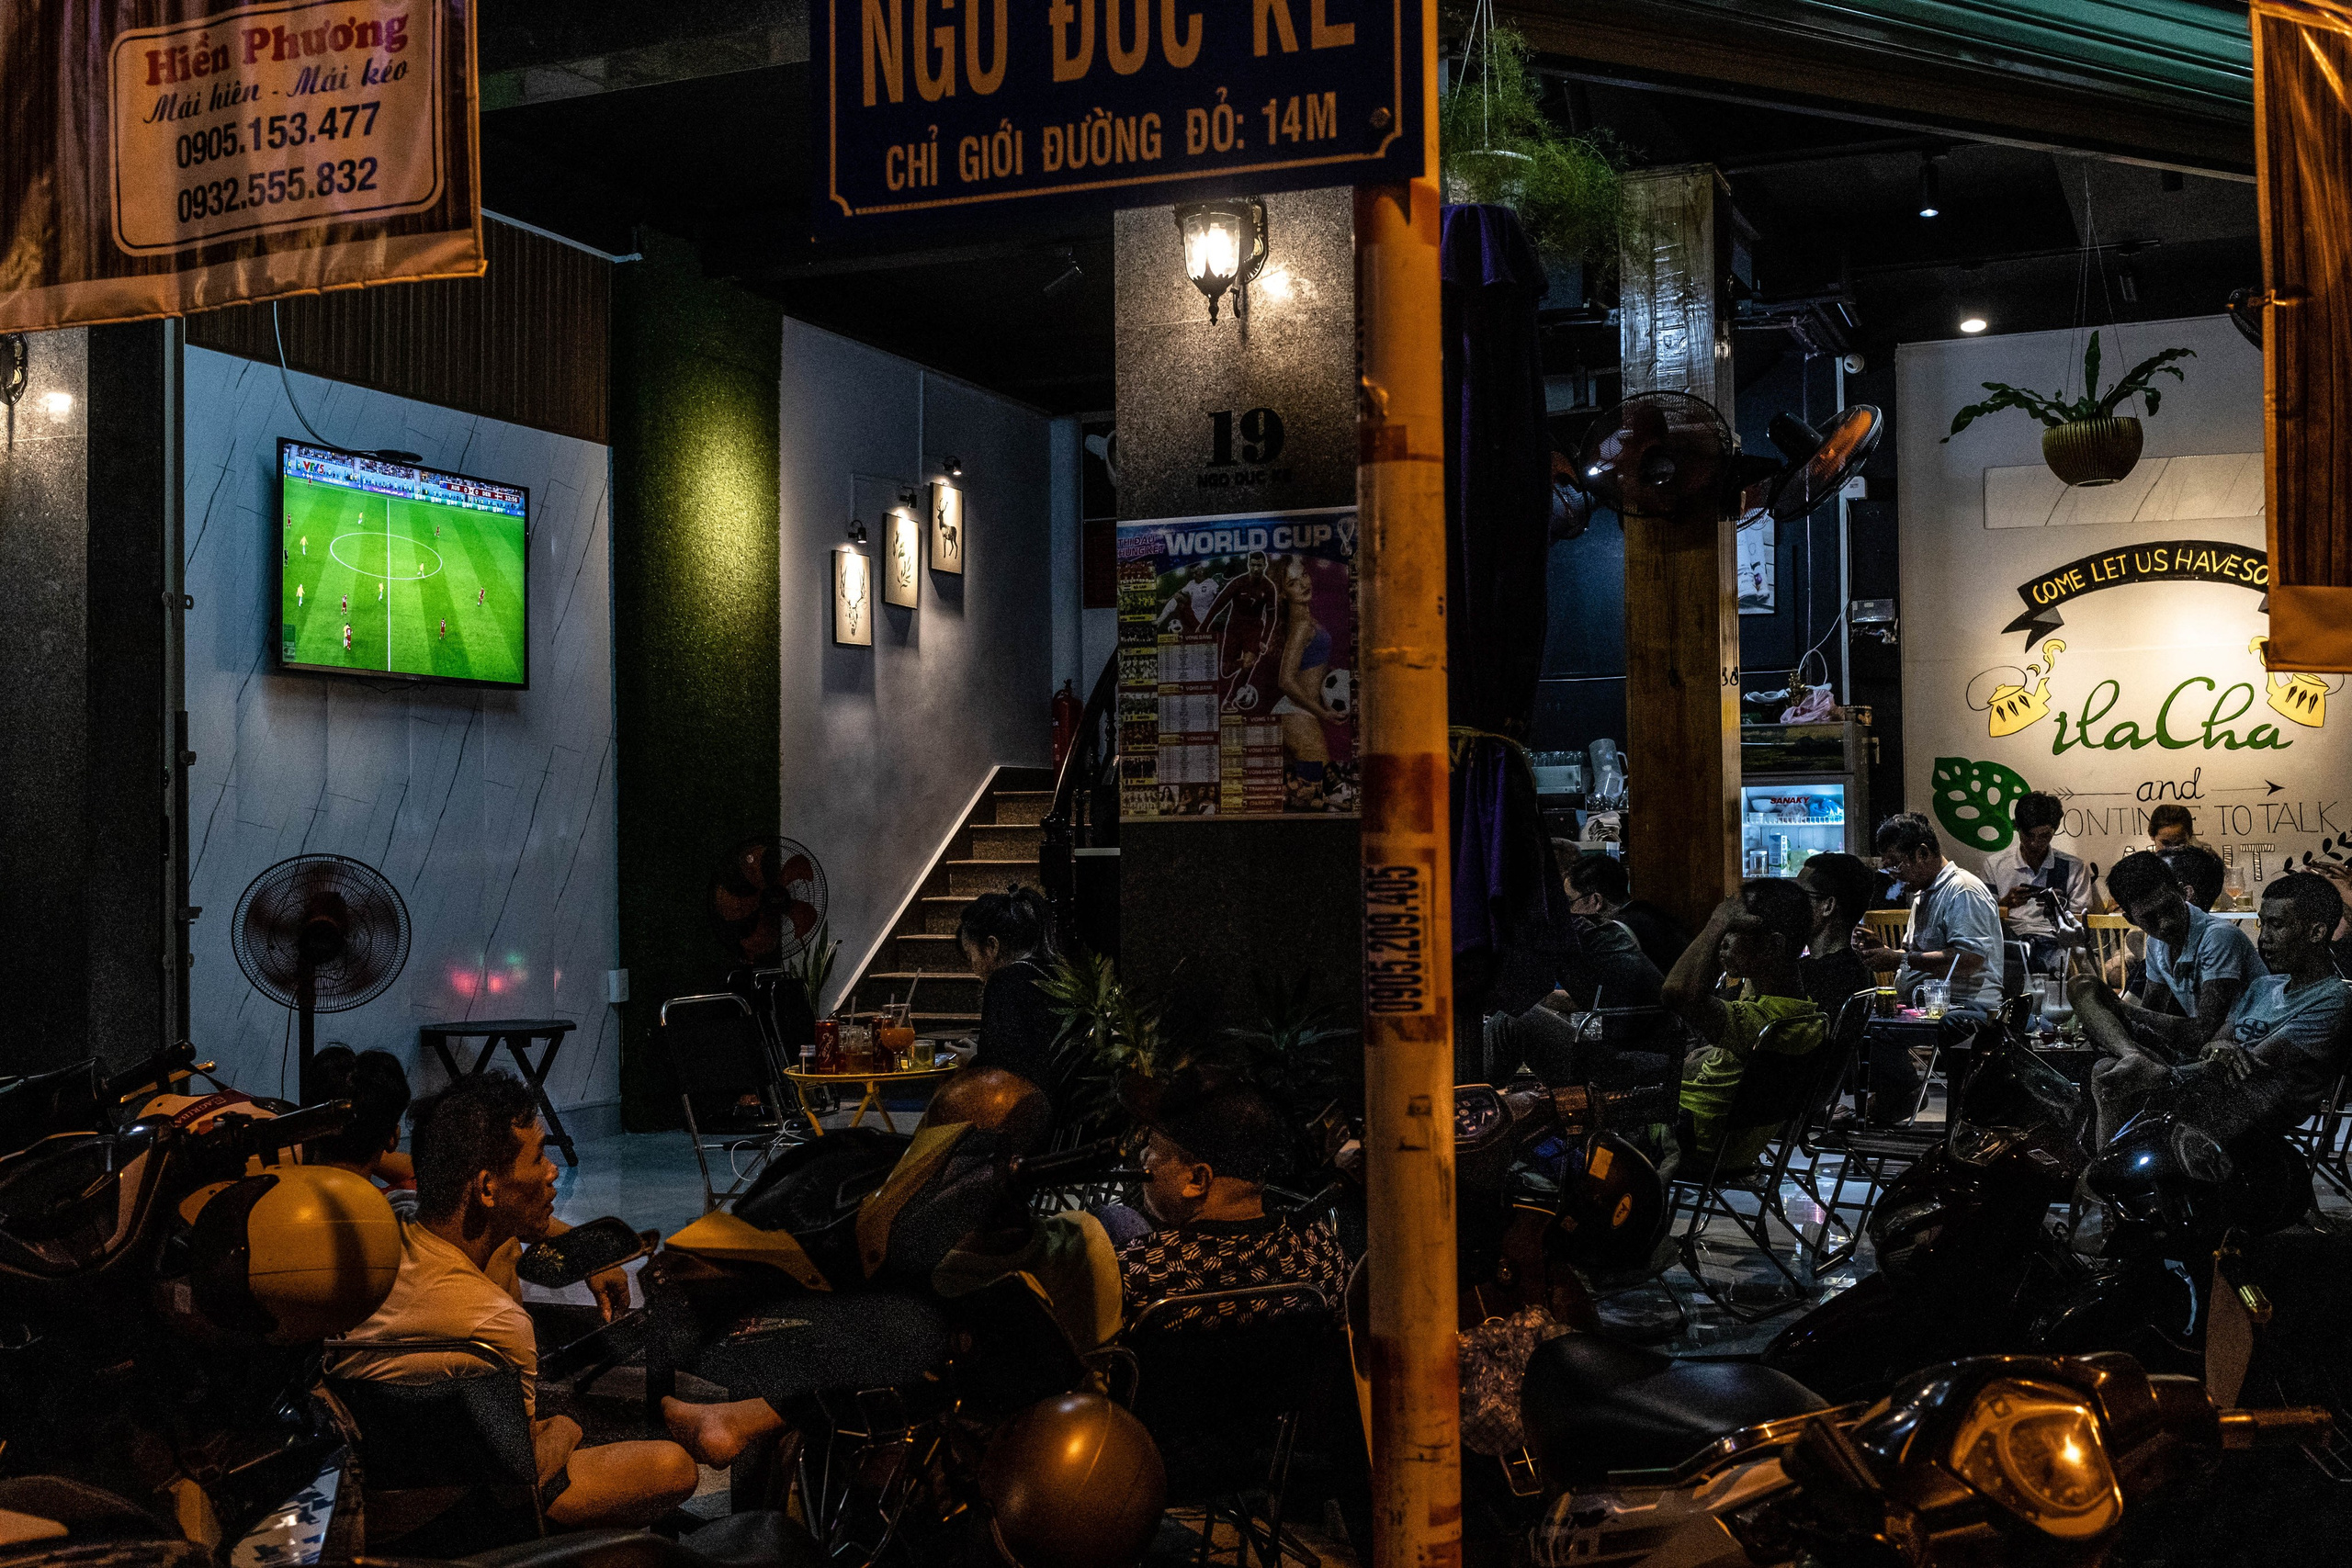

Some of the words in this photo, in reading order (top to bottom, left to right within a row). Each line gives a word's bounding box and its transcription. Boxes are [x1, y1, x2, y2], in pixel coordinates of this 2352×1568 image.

[145, 32, 230, 85] Hiền
[242, 14, 408, 64] Phương
[143, 91, 202, 124] Mái
[209, 80, 261, 111] hiên
[286, 64, 349, 97] Mái
[361, 58, 410, 87] kéo
[176, 101, 380, 168] 0905.153.477
[885, 124, 939, 191] CHỈ
[958, 117, 1023, 183] GIỚI
[1042, 107, 1162, 173] ĐƯỜNG
[1185, 85, 1245, 155] ĐỎ:
[1261, 91, 1337, 145] 14M
[177, 156, 379, 223] 0932.555.832
[1206, 407, 1284, 468] 19
[1164, 526, 1268, 557] WORLD
[1273, 524, 1332, 549] CUP
[2032, 569, 2086, 604] COME
[2090, 554, 2127, 584] LET
[2134, 548, 2169, 573] US
[2175, 548, 2242, 577] HAVE
[1770, 795, 1810, 805] SANAKY
[2136, 767, 2205, 802] and
[2214, 805, 2252, 837] TO
[2257, 800, 2340, 834] TALK
[1367, 865, 1422, 1012] 0905.209.405
